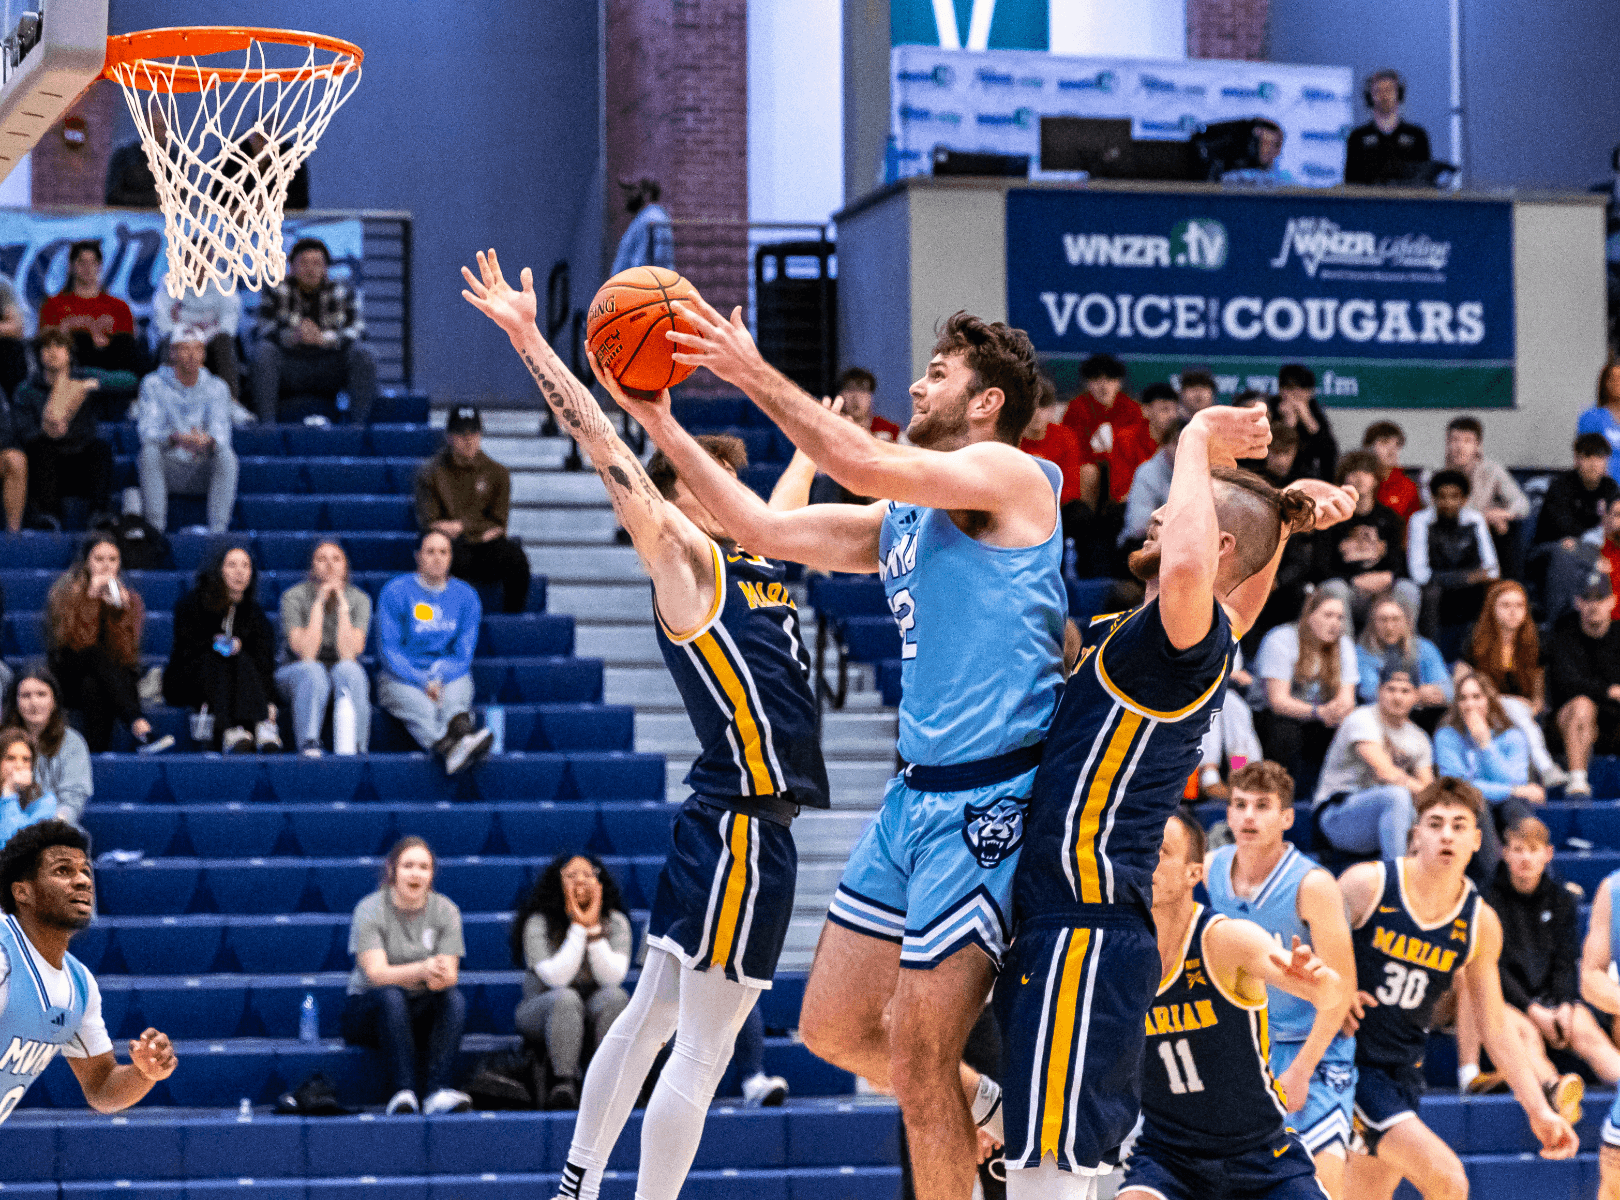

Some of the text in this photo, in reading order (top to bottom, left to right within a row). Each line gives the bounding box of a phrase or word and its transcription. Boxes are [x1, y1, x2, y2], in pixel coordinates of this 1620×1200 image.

[1042, 292, 1205, 339] VOICE
[1222, 297, 1485, 344] COUGARS
[1371, 926, 1458, 973] MARIAN
[1376, 961, 1429, 1010] 30
[1145, 1000, 1218, 1036] ARIAN
[1158, 1038, 1204, 1094] 11
